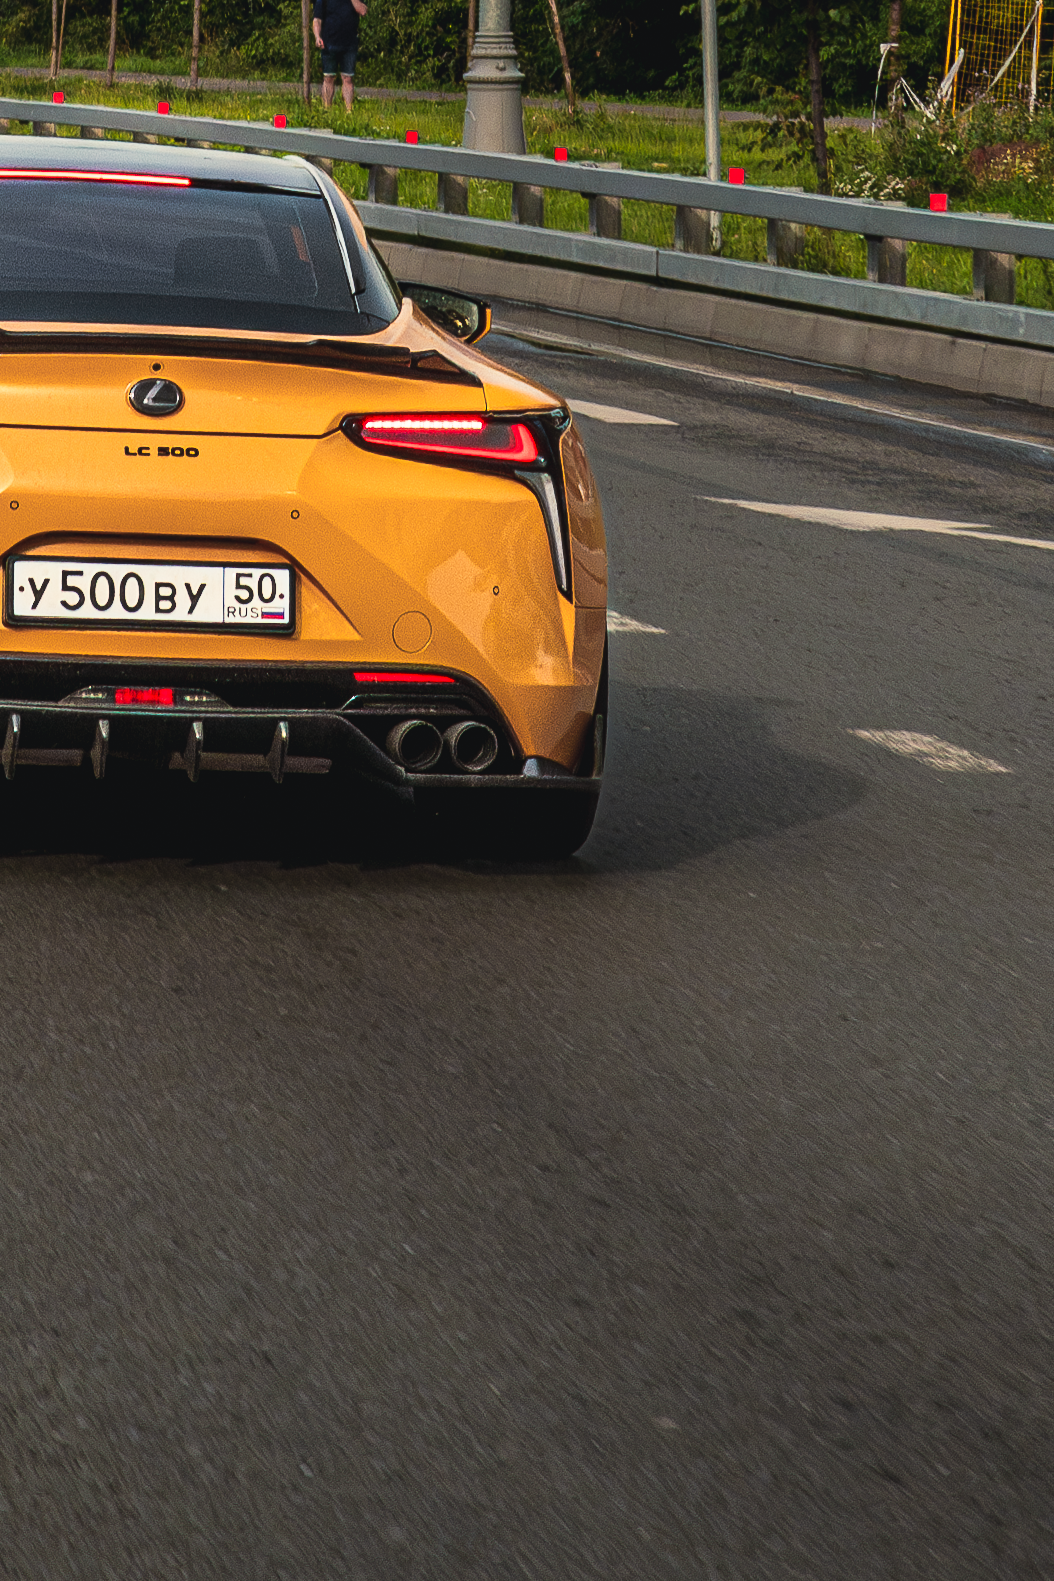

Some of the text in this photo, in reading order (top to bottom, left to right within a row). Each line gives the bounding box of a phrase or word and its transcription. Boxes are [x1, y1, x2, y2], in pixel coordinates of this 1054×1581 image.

[124, 446, 199, 458] LC 500
[233, 571, 277, 605] 50
[227, 606, 259, 619] RUS
